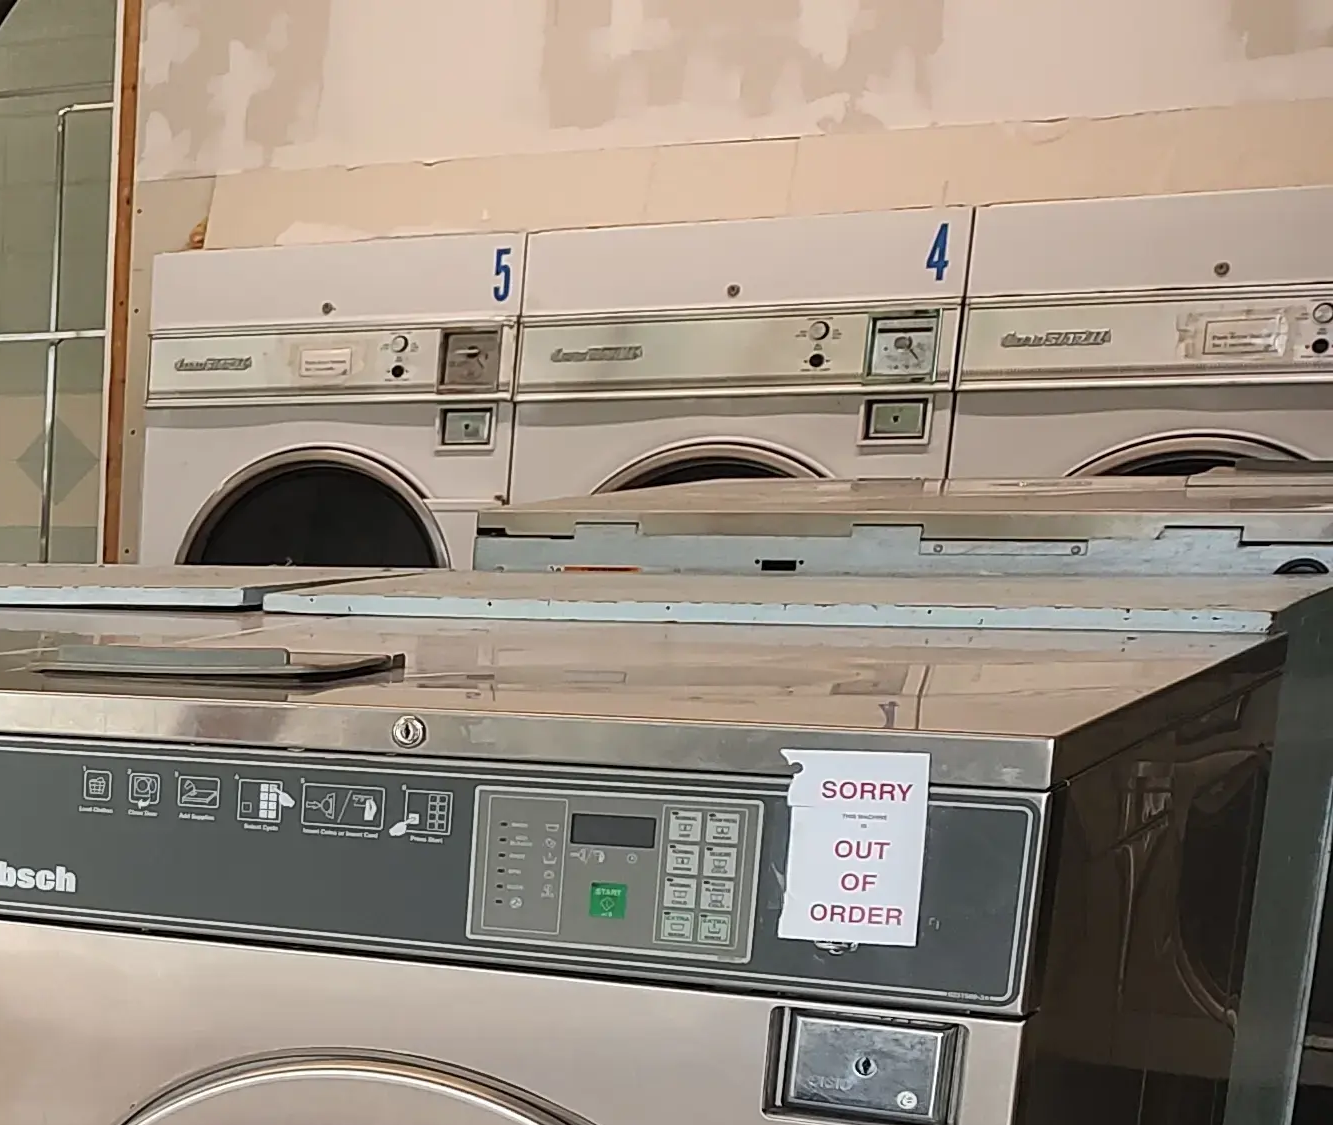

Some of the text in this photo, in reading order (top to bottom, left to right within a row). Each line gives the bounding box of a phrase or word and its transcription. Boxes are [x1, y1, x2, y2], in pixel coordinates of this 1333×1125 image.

[926, 223, 949, 281] 4
[493, 248, 511, 302] 5
[821, 781, 913, 802] SORRY
[834, 840, 890, 860] OUT
[595, 887, 623, 897] START
[840, 873, 877, 892] OF
[810, 903, 903, 926] ORDER
